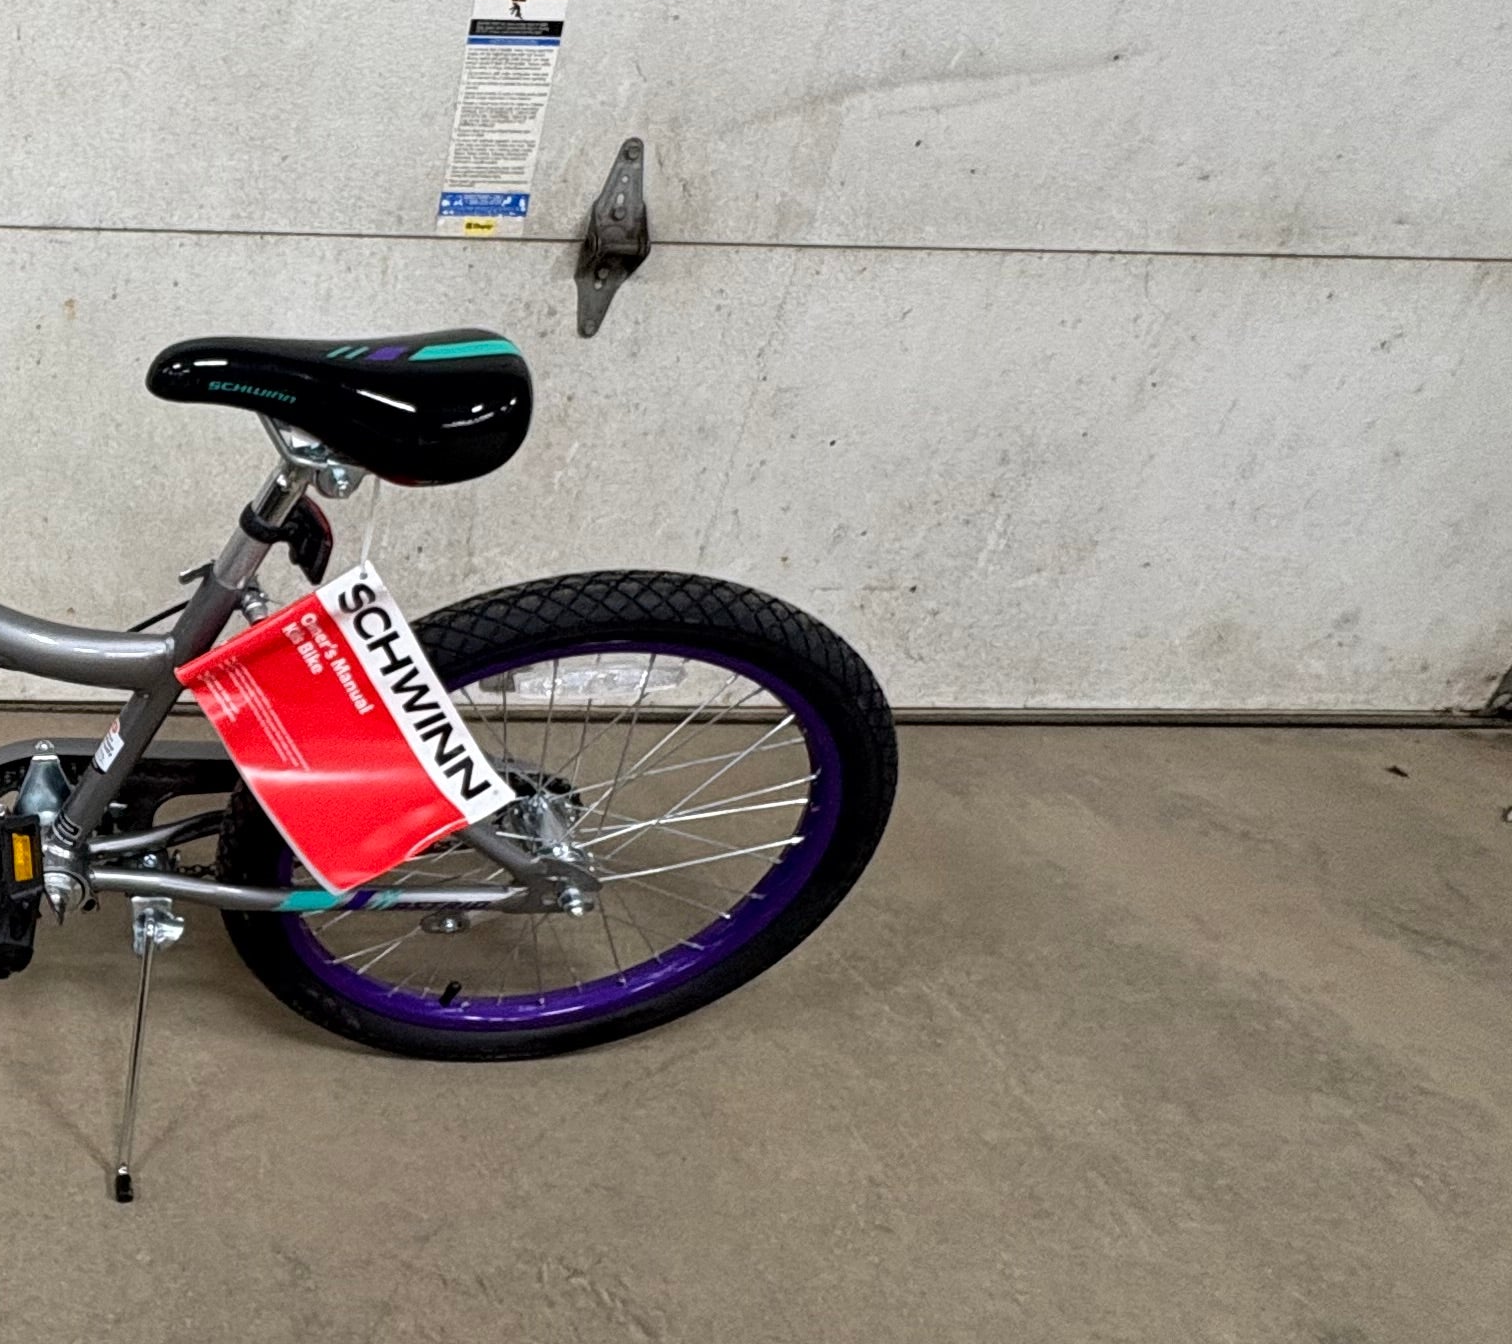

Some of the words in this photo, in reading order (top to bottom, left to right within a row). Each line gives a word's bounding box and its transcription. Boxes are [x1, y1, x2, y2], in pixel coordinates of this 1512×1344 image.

[208, 381, 297, 404] SCHWINN
[297, 641, 324, 675] Bike
[330, 657, 376, 716] Manual
[338, 582, 492, 801] SCHWINN
